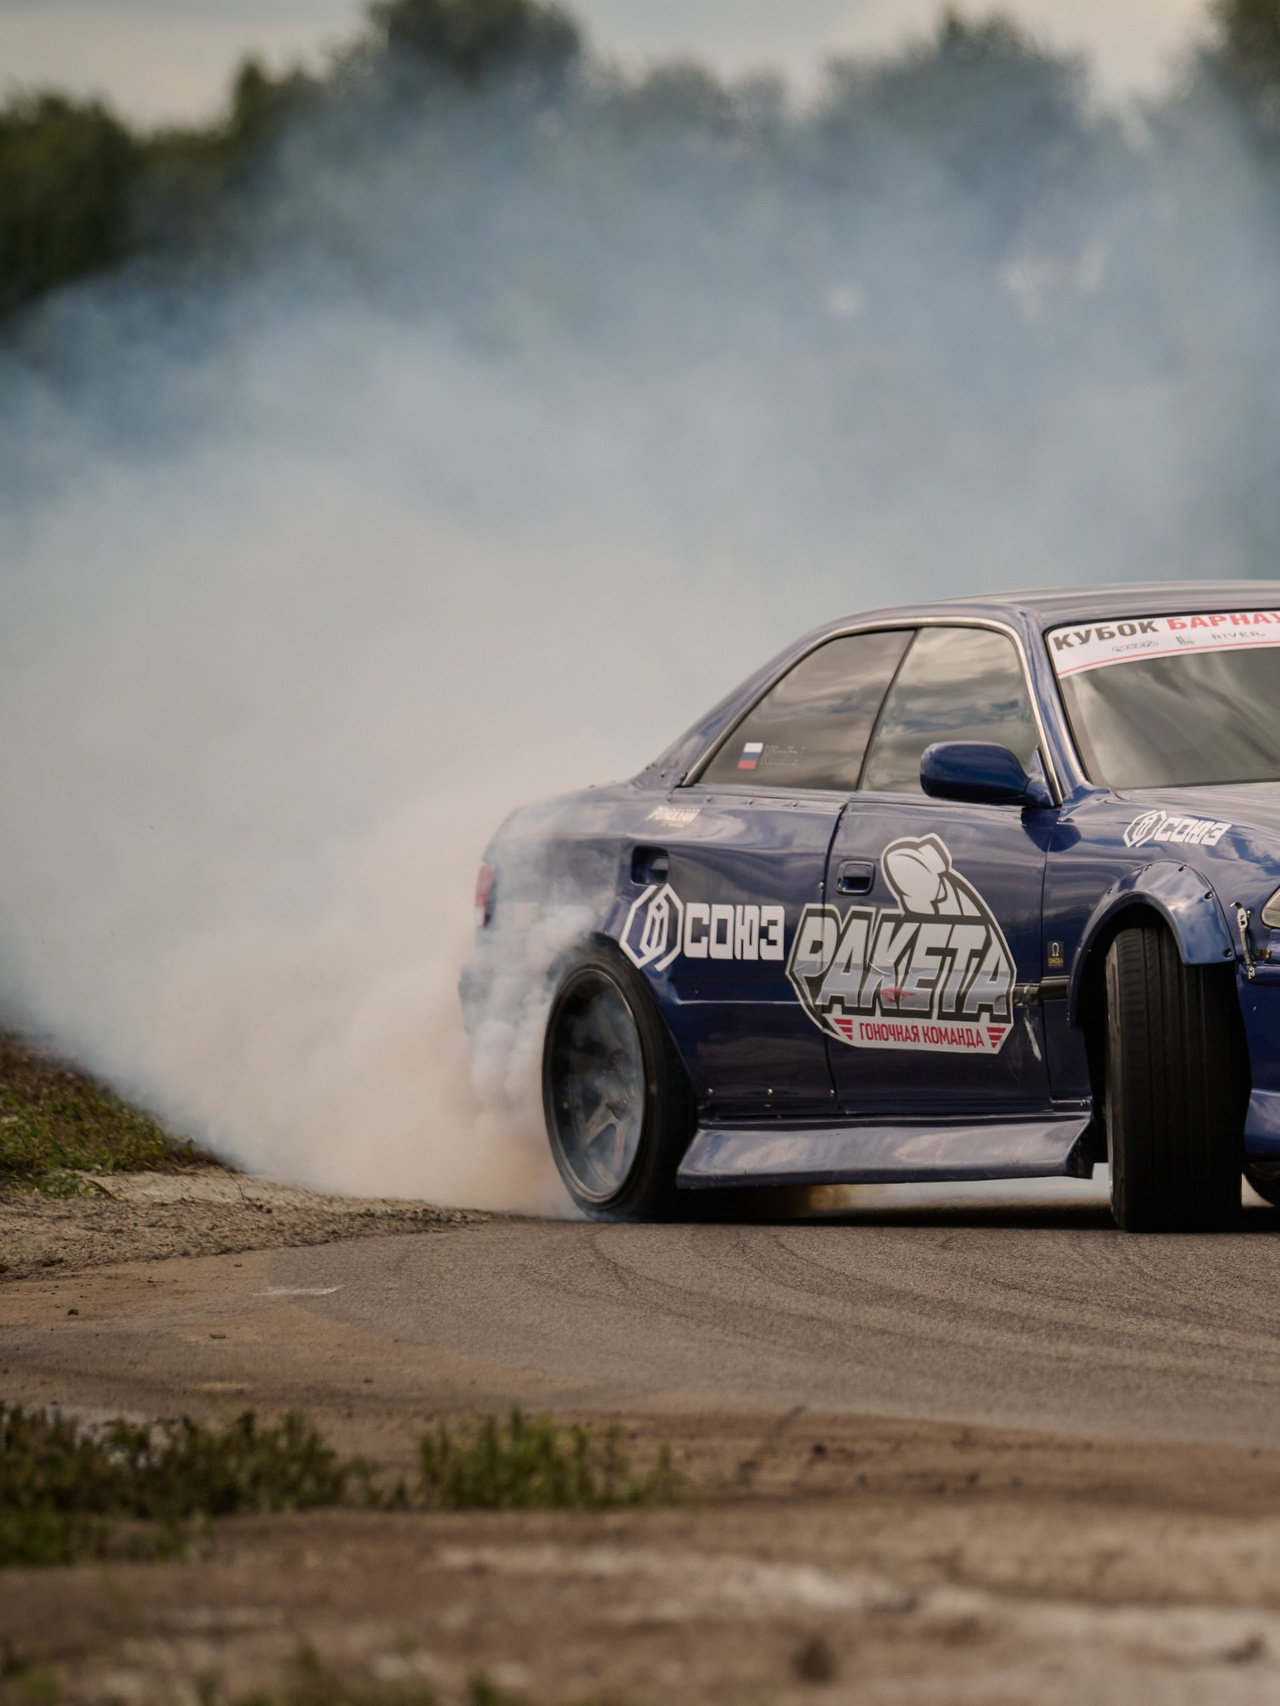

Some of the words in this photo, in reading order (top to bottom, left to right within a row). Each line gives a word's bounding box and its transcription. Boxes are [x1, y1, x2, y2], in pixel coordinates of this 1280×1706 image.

[1052, 619, 1160, 651] КУБОК
[1154, 817, 1233, 847] СОЮЗ
[683, 902, 785, 961] СОЮЗ
[793, 905, 1012, 1020] РАКЕТА
[859, 1022, 920, 1043] ГОНОЧНАЯ
[921, 1025, 985, 1048] КОМАНДА
